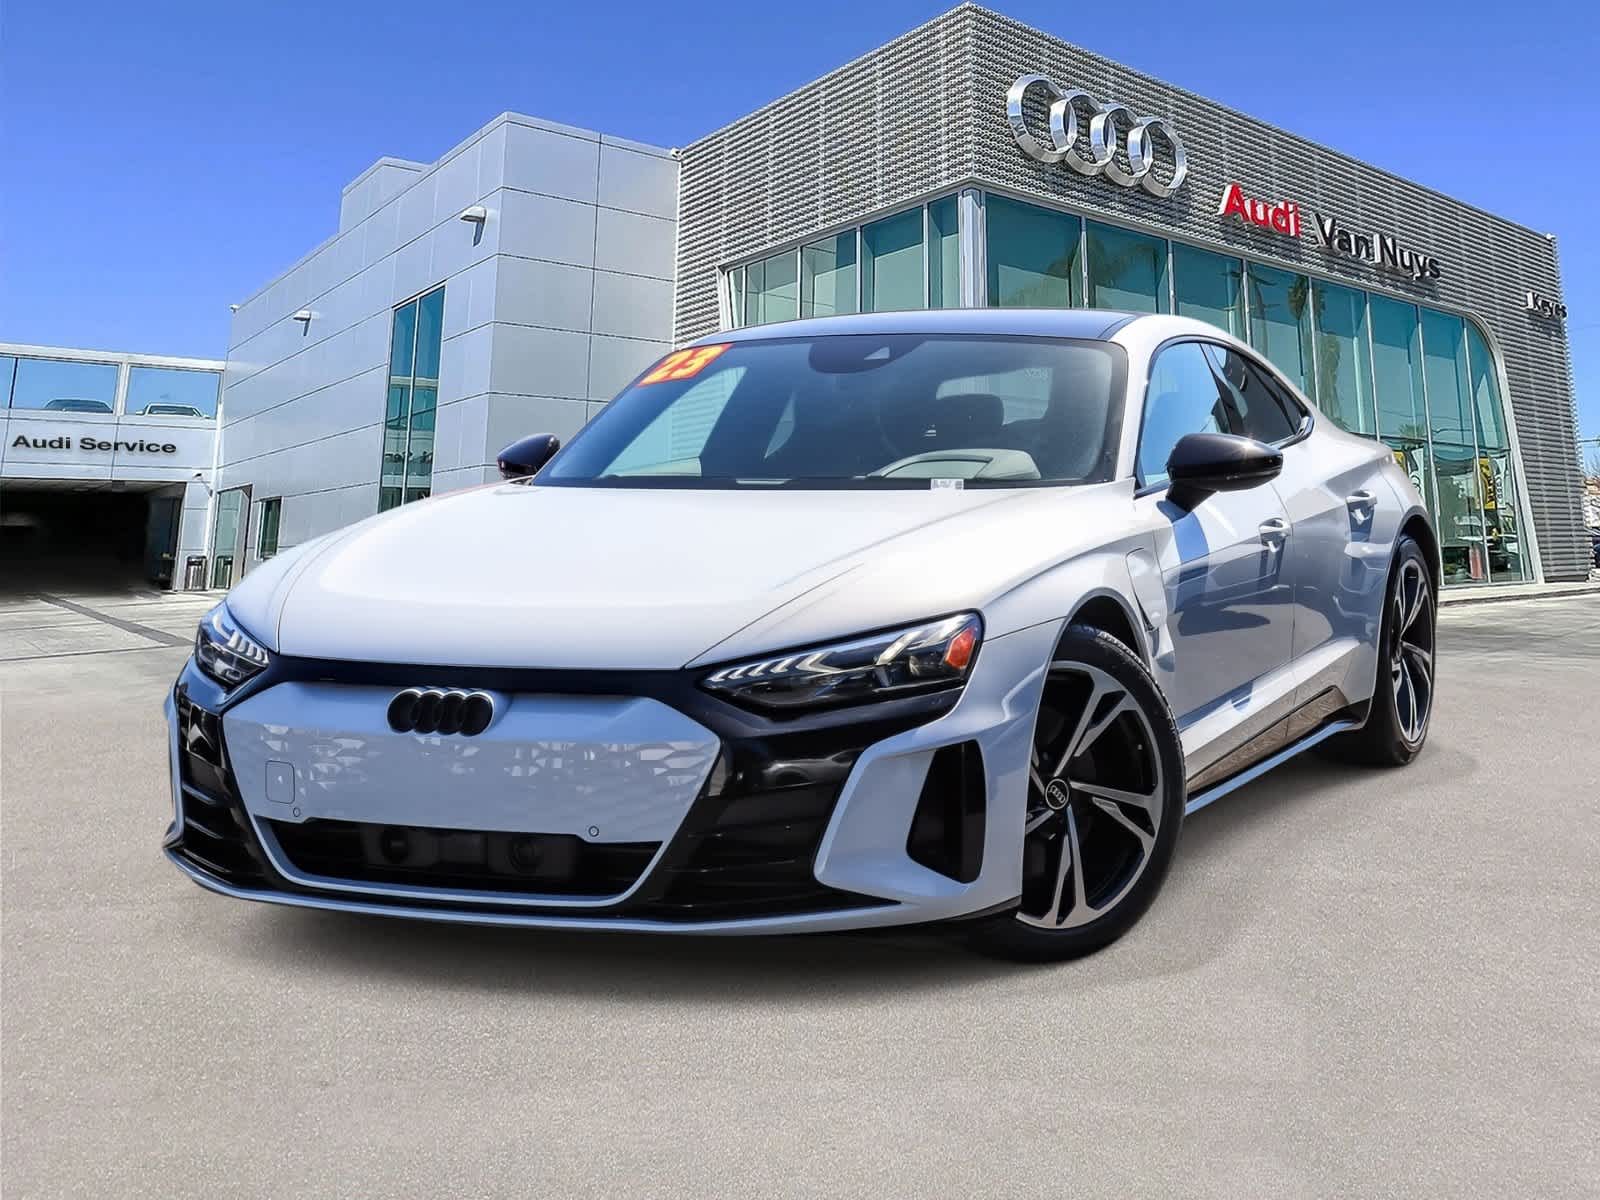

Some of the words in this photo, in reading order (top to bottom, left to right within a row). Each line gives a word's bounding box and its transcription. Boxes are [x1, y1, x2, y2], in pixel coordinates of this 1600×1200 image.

[1219, 182, 1301, 237] Audi
[1312, 212, 1370, 259] Van
[1374, 232, 1441, 281] Nuys
[641, 346, 723, 384] 23
[12, 435, 72, 449] Audi
[79, 437, 177, 454] Service
